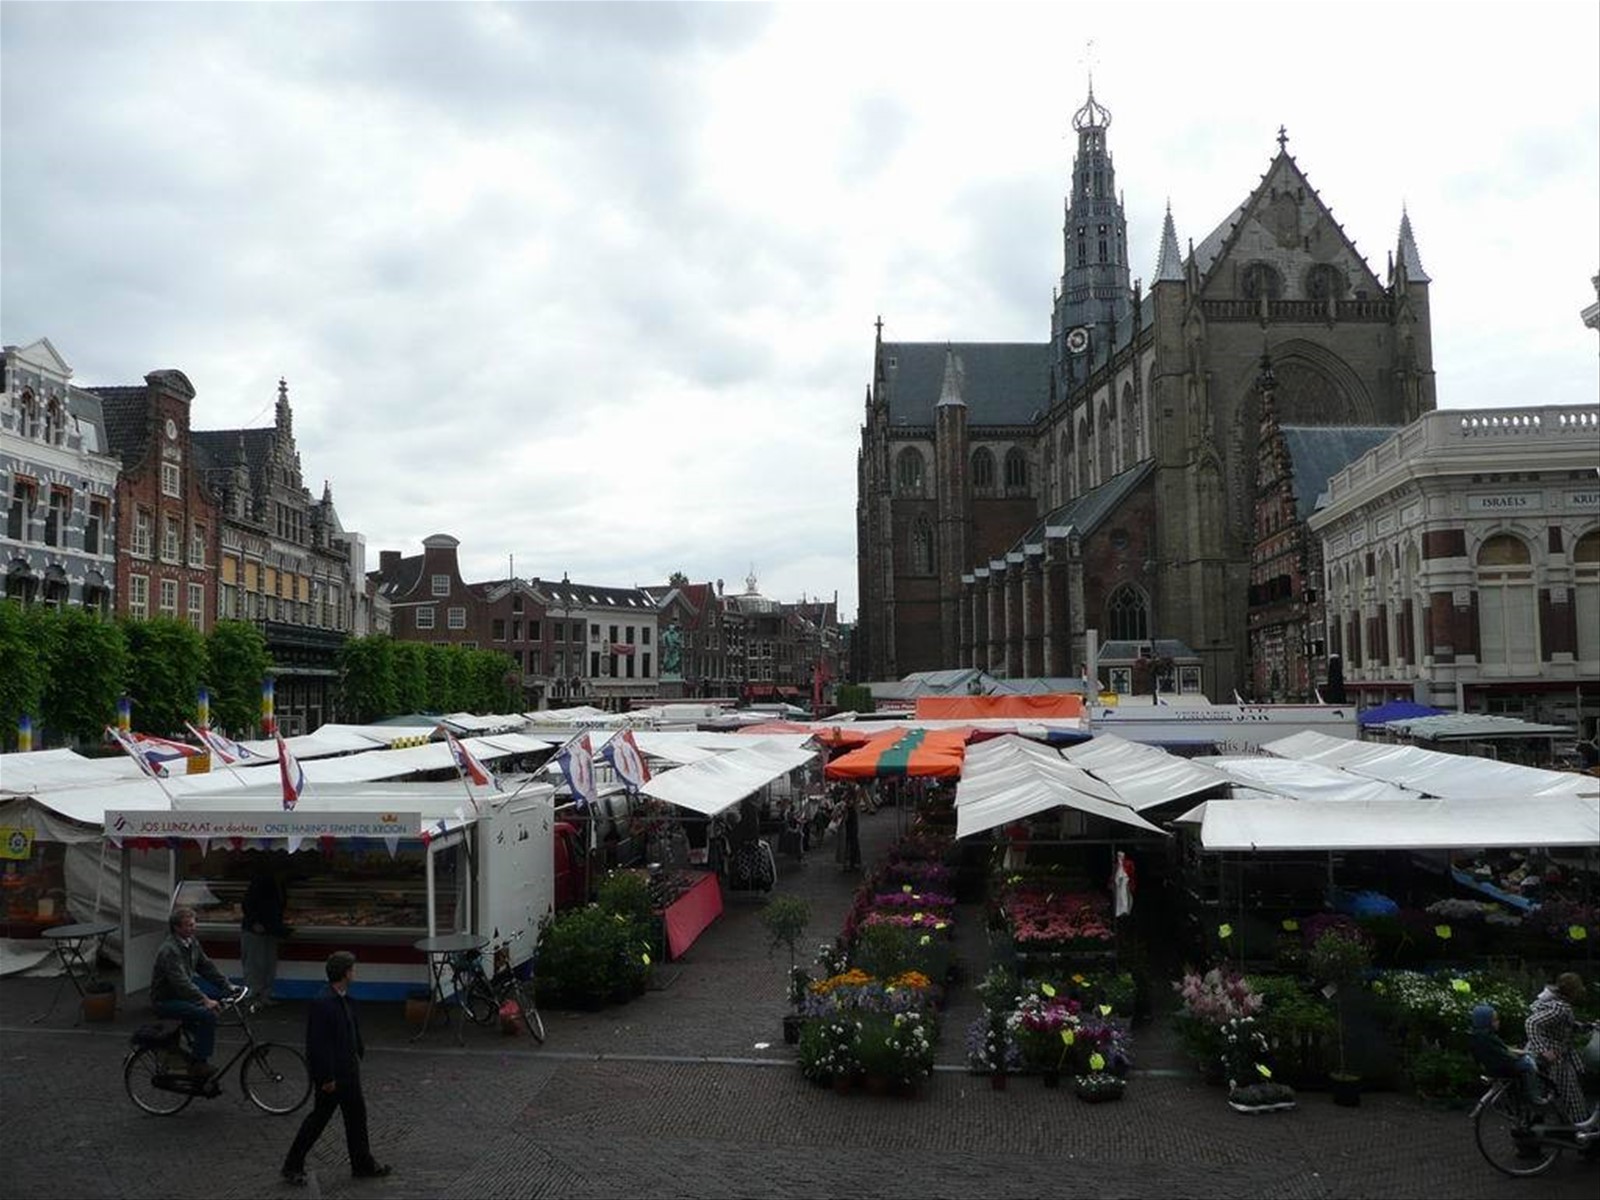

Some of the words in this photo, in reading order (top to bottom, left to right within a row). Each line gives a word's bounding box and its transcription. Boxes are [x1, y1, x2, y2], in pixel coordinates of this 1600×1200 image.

[1573, 495, 1600, 504] KRU
[140, 822, 159, 832] JOS
[264, 823, 289, 833] ONZE
[359, 823, 370, 833] DE
[373, 823, 406, 833] KROON
